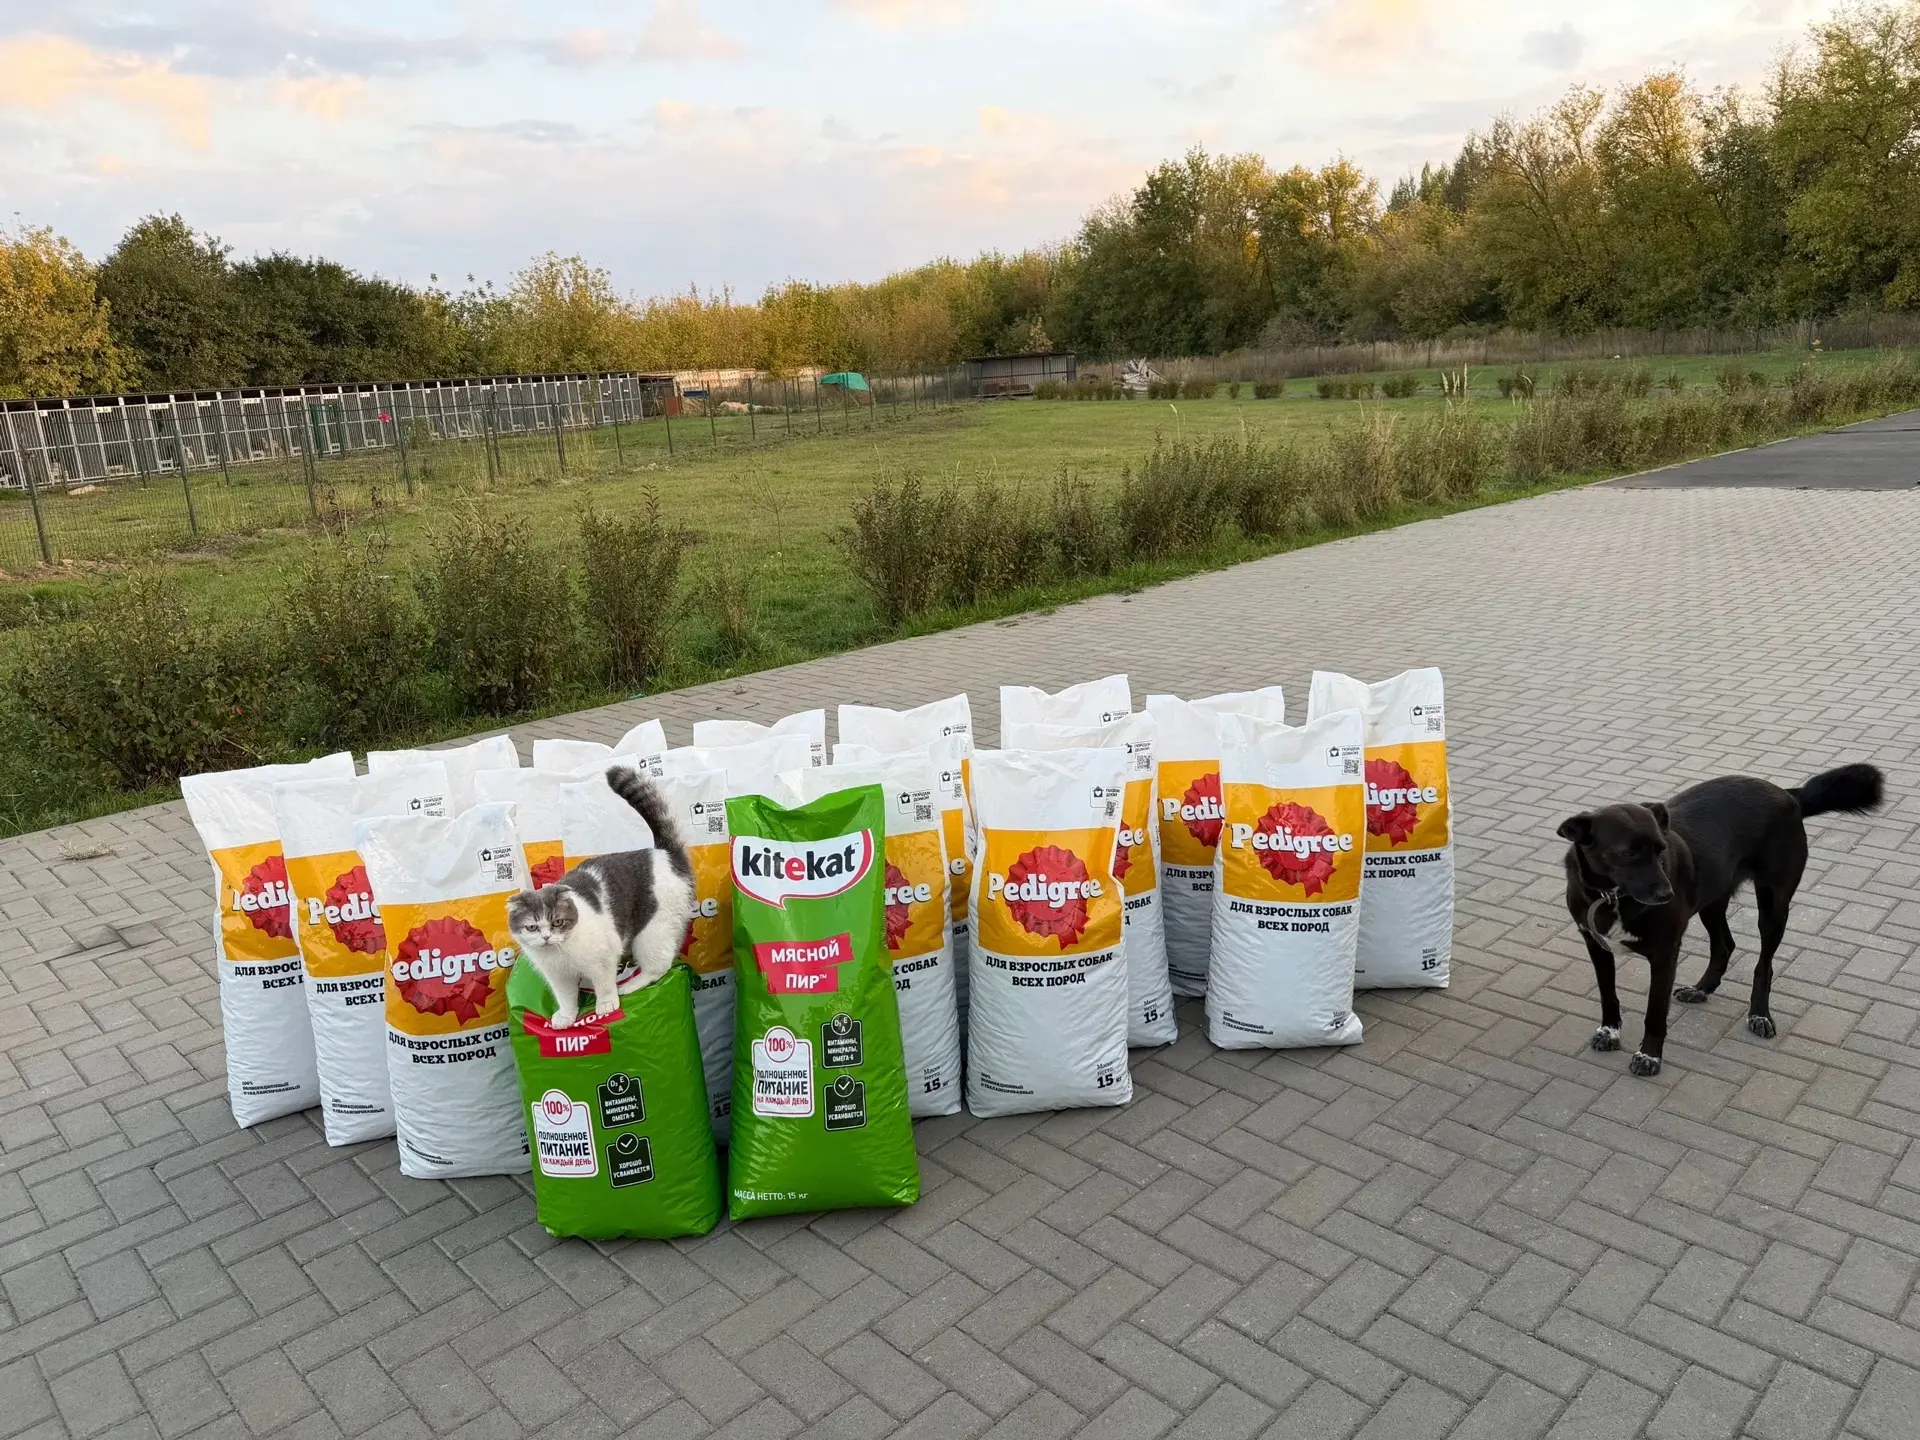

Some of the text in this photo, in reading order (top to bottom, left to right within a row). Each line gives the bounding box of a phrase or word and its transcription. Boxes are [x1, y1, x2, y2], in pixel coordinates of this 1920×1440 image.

[1365, 782, 1439, 811] igree
[1162, 796, 1225, 822] Pedi
[1230, 823, 1353, 859] Pedigree
[1366, 852, 1441, 865] ОСЛЫХ СОБАК
[1166, 868, 1187, 878] ДЛЯ
[1379, 868, 1415, 878] ПОРОД
[986, 872, 1104, 908] Pedigree
[1192, 883, 1214, 892] ВСЕ
[1230, 901, 1352, 918] ДЛЯ ВЗРОСЛЫХ СОБАК
[1257, 920, 1330, 933] ВСЕХ ПОРОД
[771, 939, 840, 963] МЯСНОЙ
[235, 961, 302, 977] ДЛЯ ВЗРОС
[392, 947, 516, 984] edigree
[901, 957, 938, 974] СОБАК
[986, 952, 1113, 972] ДЛЯ ВЗРОСЛЫХ СОБАК
[1422, 958, 1436, 971] 15
[262, 978, 297, 990] ВСЕХ
[316, 978, 384, 994] ДЛЯ ВЗРОСЛ
[1012, 972, 1085, 987] ВСЕХ ПОРОД
[345, 994, 377, 1006] ВСЕХ
[1144, 1009, 1158, 1024] 15
[389, 1027, 510, 1051] ДЛЯ ВЗРОСЛЫХ СОБ
[768, 1037, 793, 1052] 100%
[412, 1046, 496, 1064] ВСЕХ ПОРОД
[756, 1070, 807, 1080] ПОЛНОЦЕННОЕ
[1097, 1074, 1114, 1089] 15
[757, 1080, 808, 1096] ПИТАНИЕ
[924, 1077, 941, 1094] 15
[545, 1101, 569, 1114] 100%
[765, 1096, 790, 1106] КАЖДЫЙ
[792, 1097, 809, 1106] ДЕНЬ
[834, 1103, 856, 1112] ХОРОШО
[828, 1110, 863, 1121] УСВАИВАЕТСЯ
[539, 1131, 588, 1142] ПОЛНОЦЕННОЕ
[540, 1142, 590, 1157] ПИТАНИЕ
[549, 1158, 574, 1167] КАЖДЫЙ
[575, 1158, 592, 1167] ДЕНЬ
[619, 1159, 642, 1169] ХОРОШО
[613, 1165, 651, 1179] УСВАИВАЕТСЯ
[734, 1189, 755, 1200] МАССА
[757, 1192, 786, 1200] НЕТТО:
